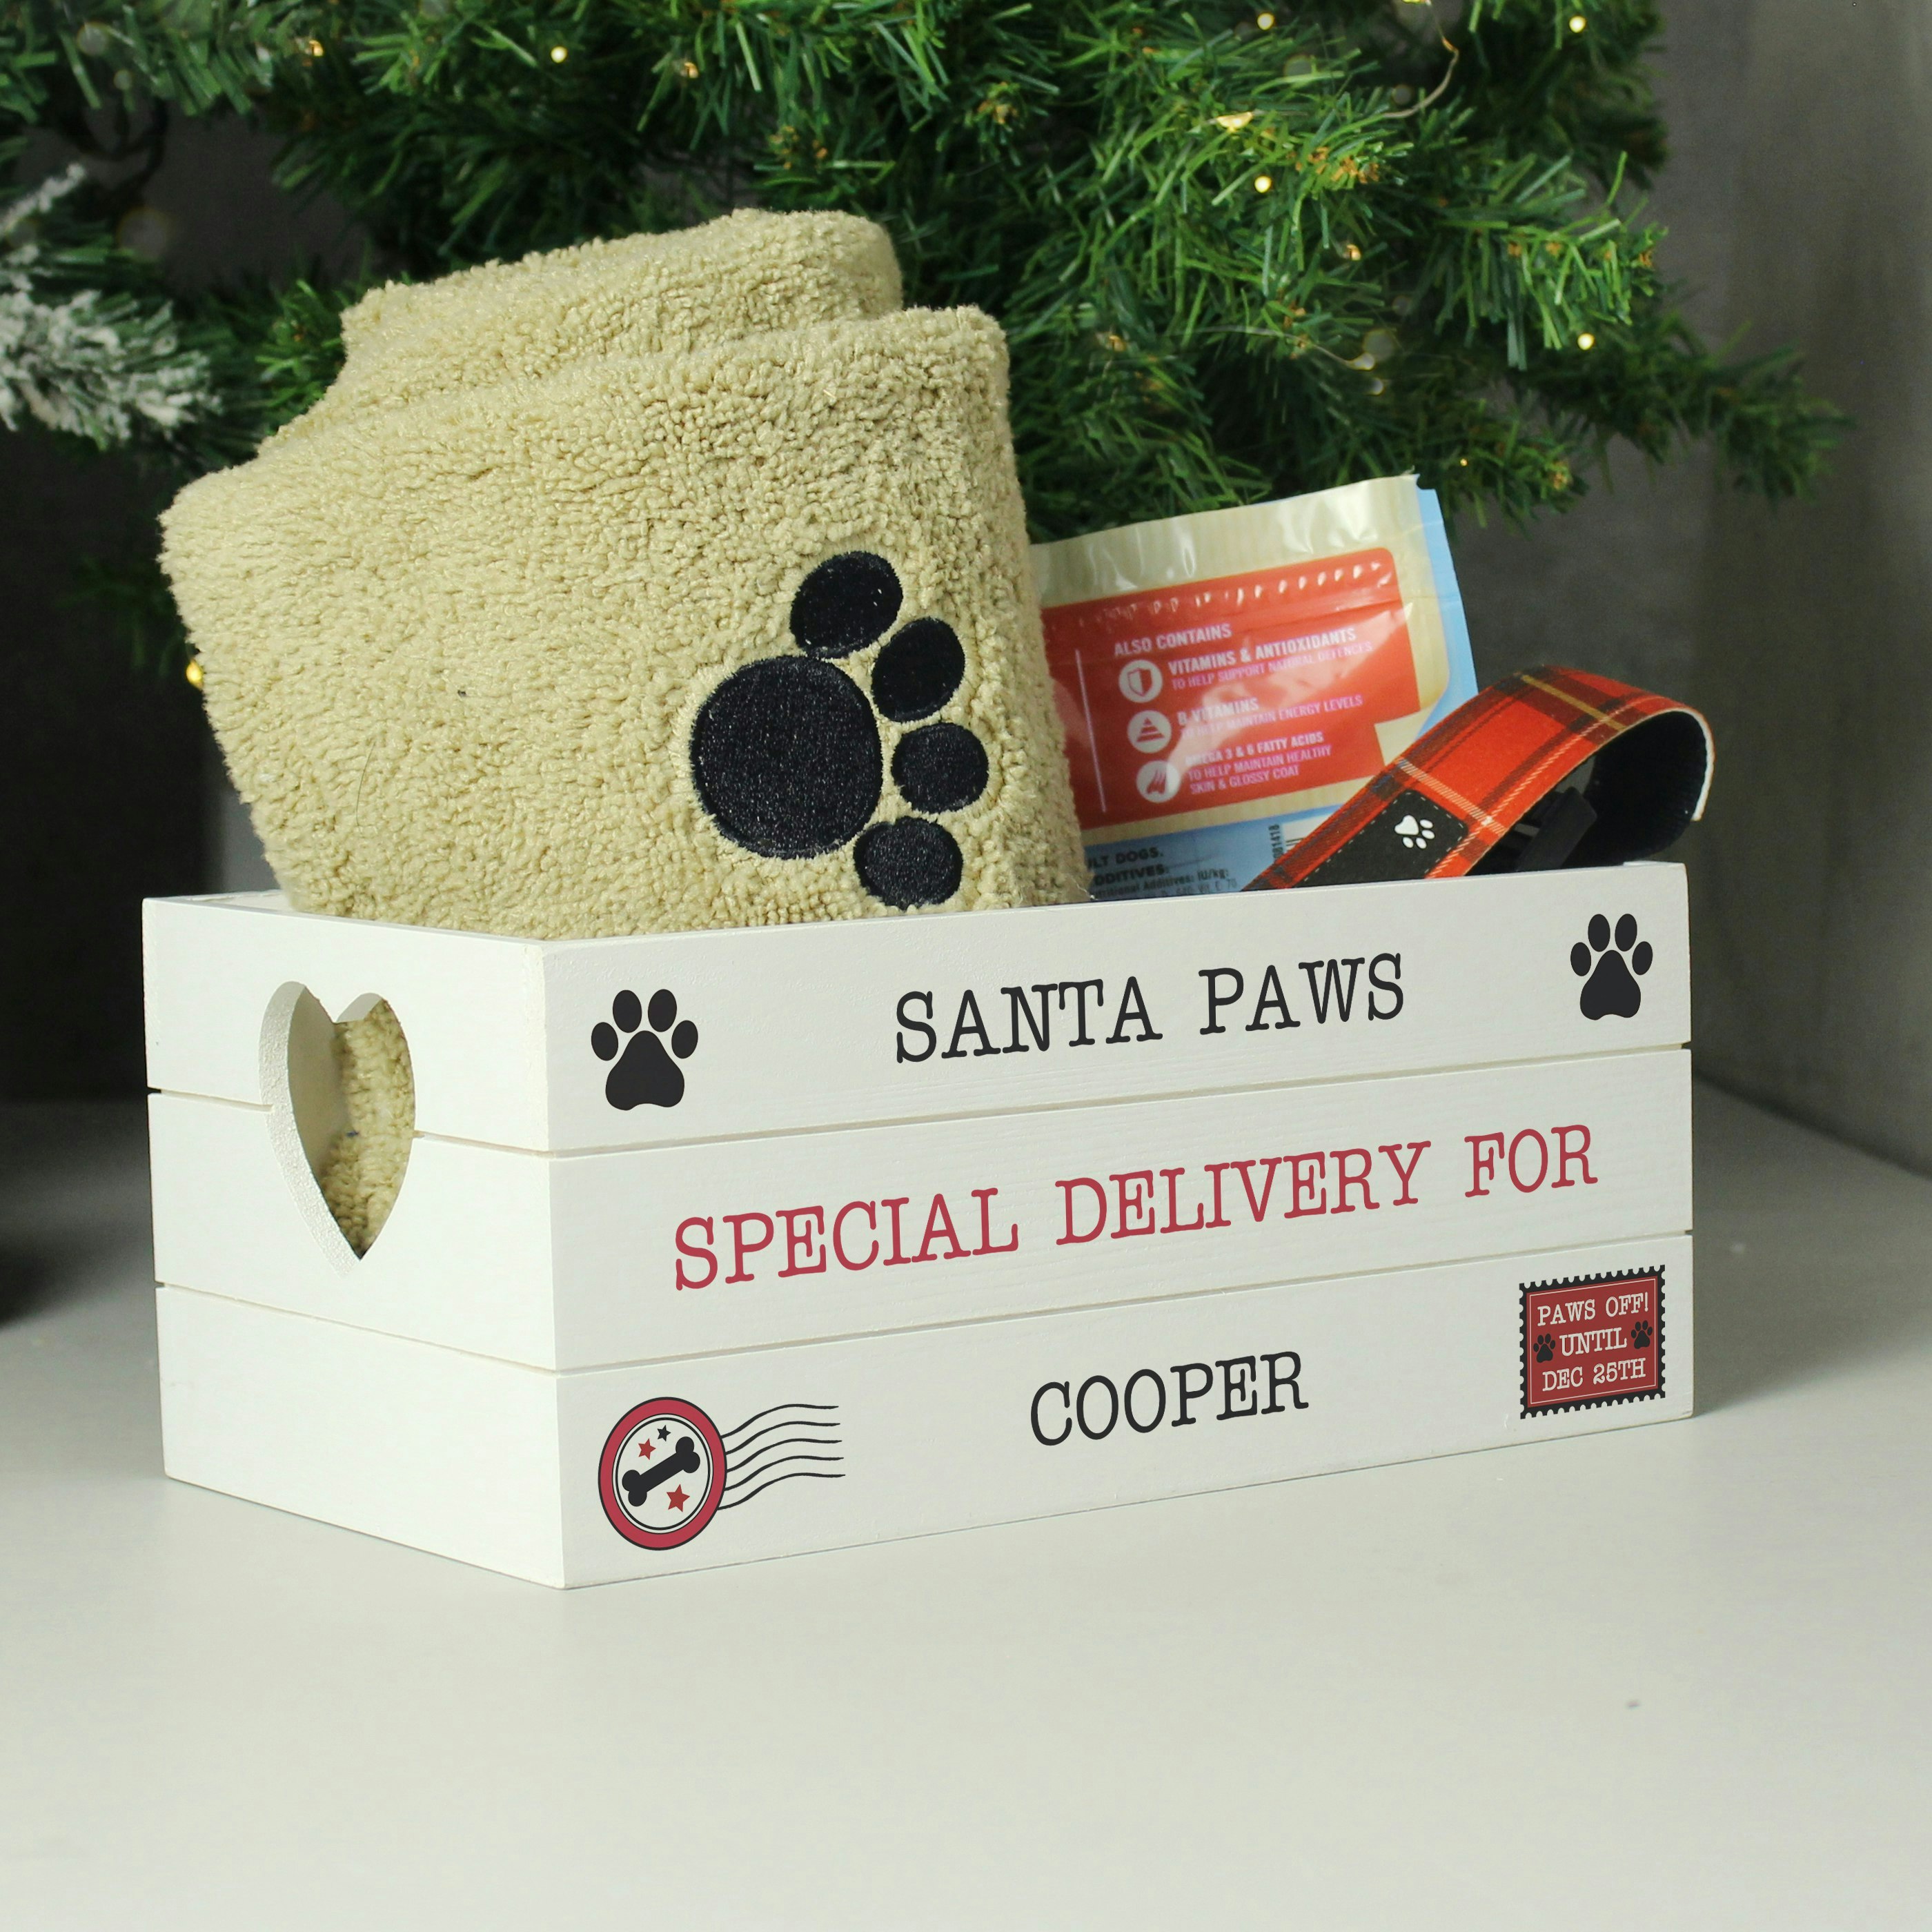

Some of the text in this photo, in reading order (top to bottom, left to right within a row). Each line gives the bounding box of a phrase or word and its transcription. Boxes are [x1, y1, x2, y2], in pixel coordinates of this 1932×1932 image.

[1114, 623, 1232, 657] ALSO CONTAINS
[1168, 627, 1357, 676] VITAMINS & ANTIOXIDANTS
[1172, 677, 1185, 689] TO
[1188, 673, 1214, 687] HELP
[1217, 662, 1265, 682] SUPPORT
[1226, 711, 1276, 731] MAINTAIN
[1279, 702, 1321, 720] ENERGY
[1324, 694, 1364, 712] LEVELS
[1188, 745, 1332, 781] TO HELP MAINTAIN HEALTHY
[1225, 748, 1234, 760] 3
[1236, 746, 1245, 758] &
[1257, 736, 1288, 753] FATTY
[1291, 731, 1324, 747] ACIDS
[1190, 764, 1301, 795] SKIN & GLOSSY COAT
[1116, 847, 1164, 865] DOGS.
[896, 952, 1403, 1064] SANTA PAWS
[675, 1124, 1599, 1291] SPECIAL DELIVERY FOR
[1537, 1291, 1649, 1327] PAWS OFF!
[1559, 1327, 1628, 1357] UNTIL
[1542, 1357, 1646, 1392] DEC 25TH
[1030, 1351, 1309, 1446] COOPER
